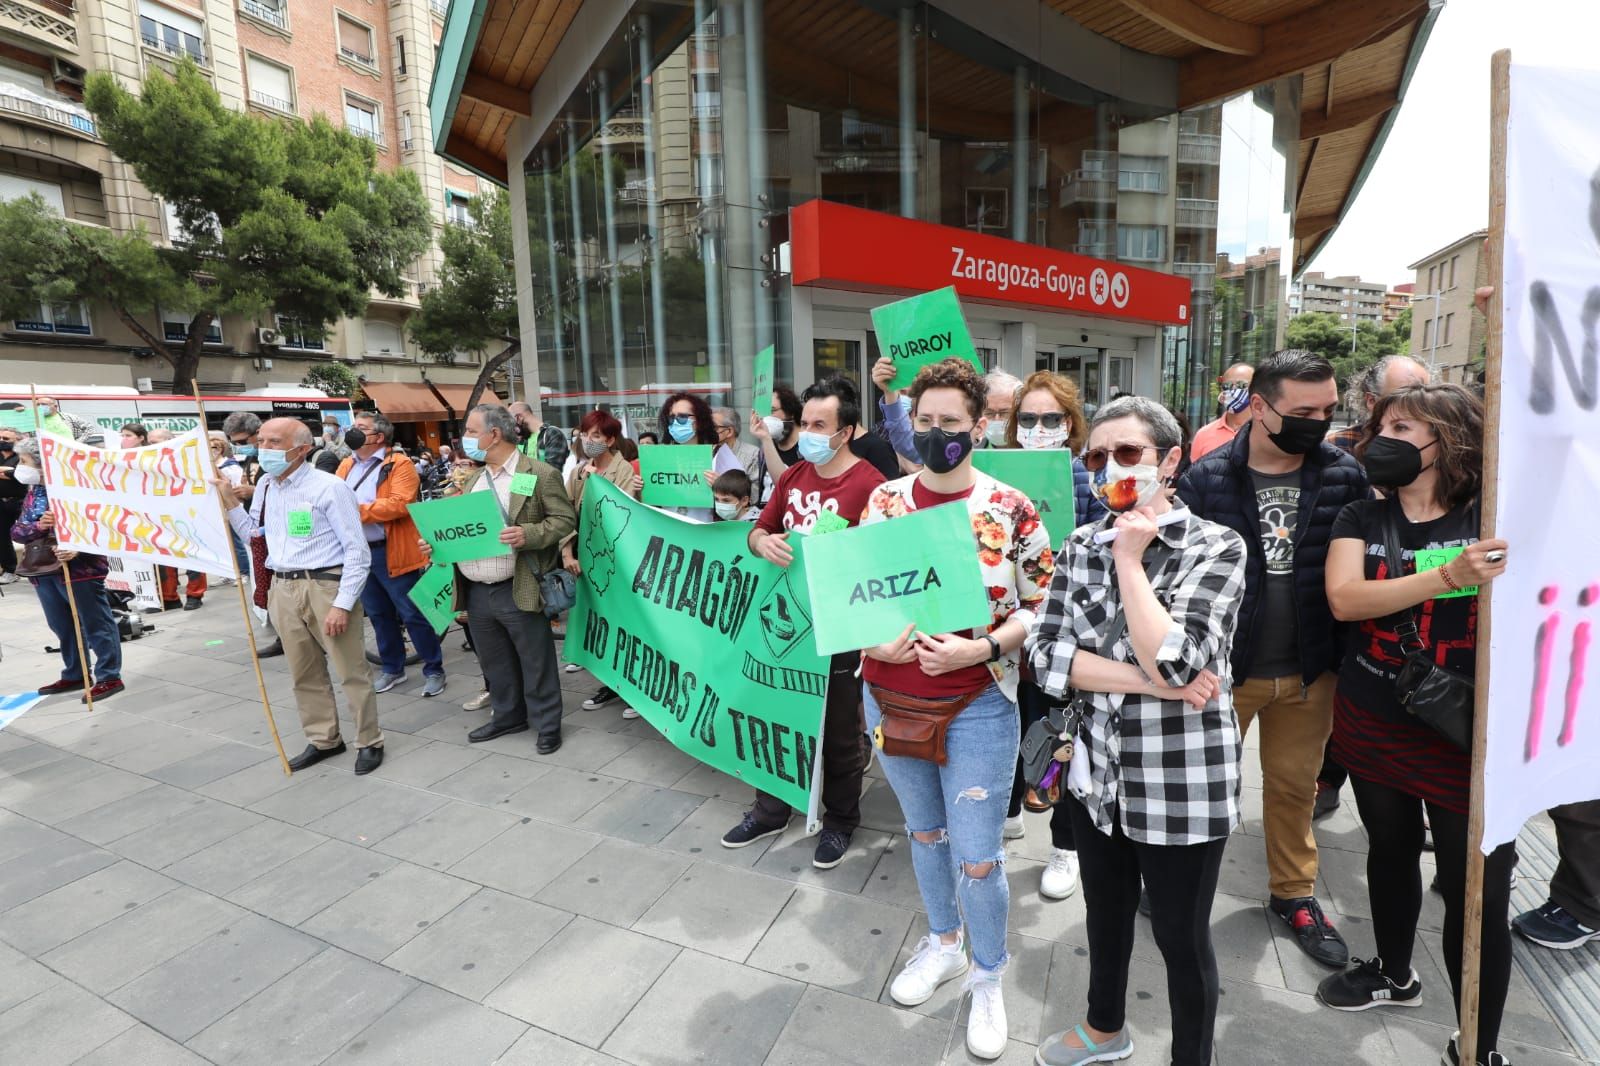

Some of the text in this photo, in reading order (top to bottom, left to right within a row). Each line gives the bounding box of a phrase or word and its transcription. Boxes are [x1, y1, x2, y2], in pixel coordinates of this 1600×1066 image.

[952, 247, 1085, 300] Zaragoza-Goya
[890, 331, 952, 361] PURROY
[650, 470, 700, 486] CETINA
[51, 498, 188, 558] UN PUEBLO
[434, 522, 487, 542] MORES
[632, 535, 759, 645] ARAGÓN
[849, 566, 942, 606] ARIZA
[583, 608, 818, 793] NO PIERDAS TU TREN
